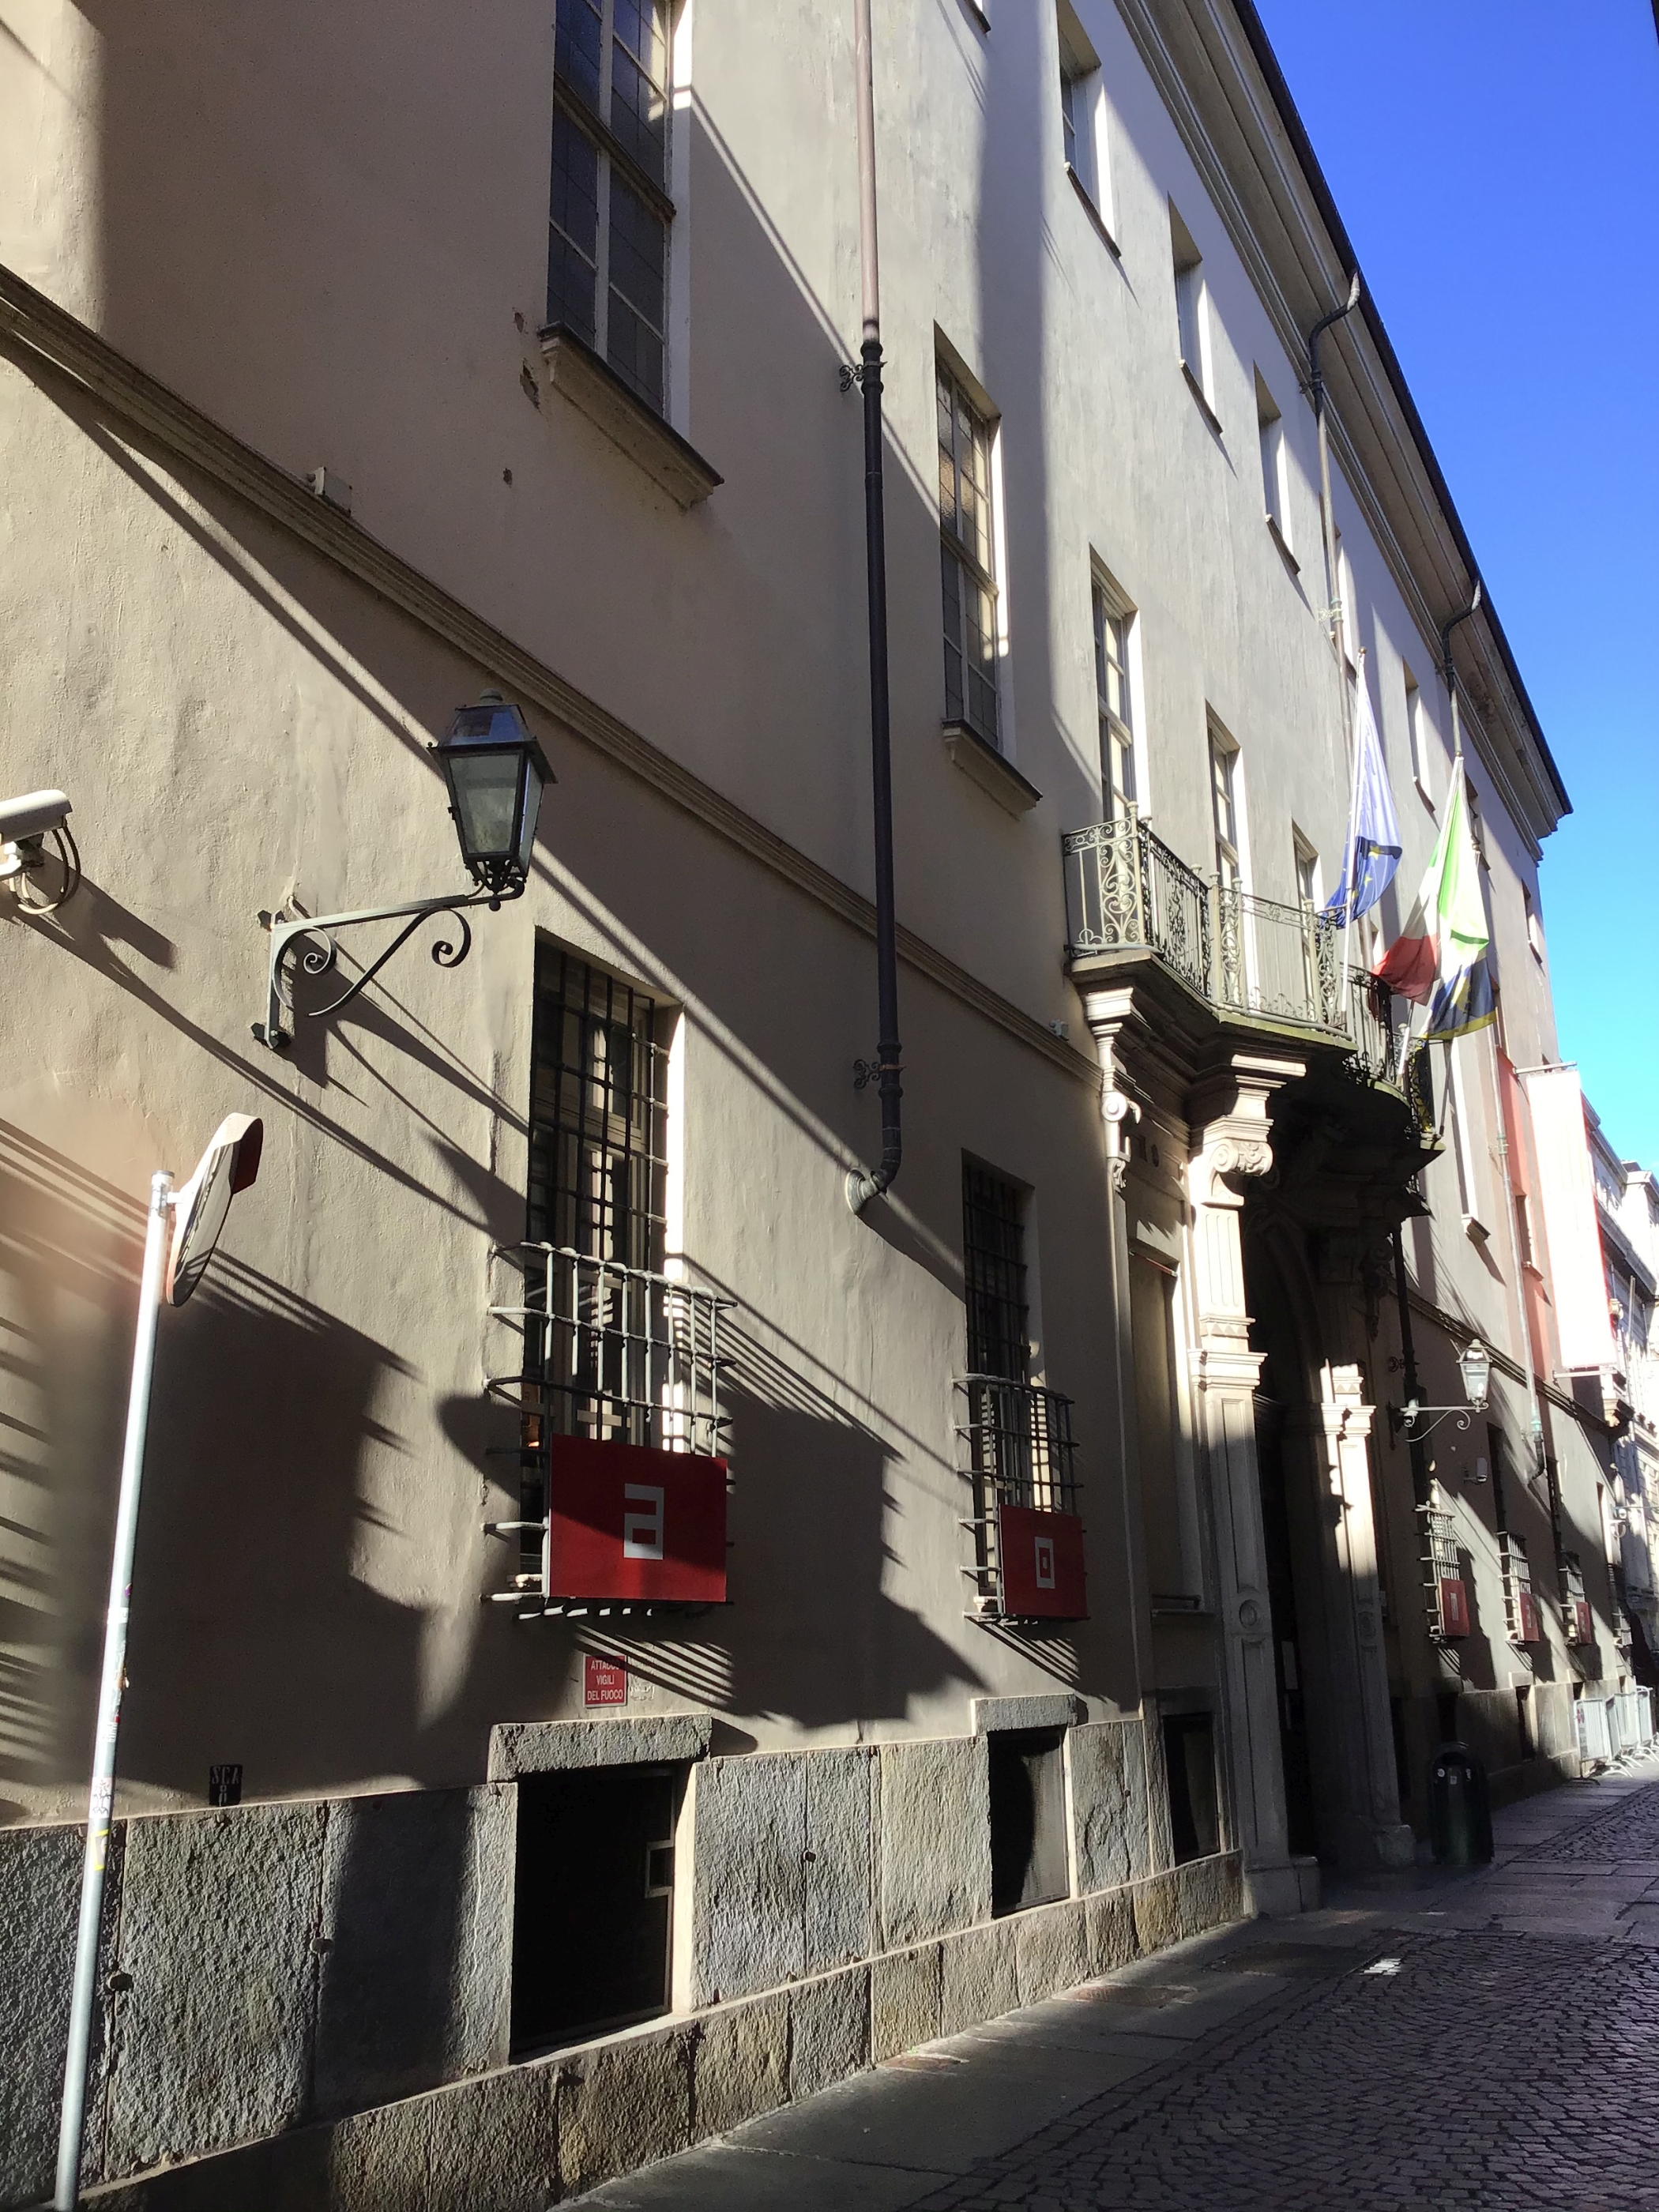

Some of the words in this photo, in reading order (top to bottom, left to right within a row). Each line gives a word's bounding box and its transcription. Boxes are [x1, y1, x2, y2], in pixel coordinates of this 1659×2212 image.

[591, 1660, 621, 1670] ATTAC
[596, 1675, 615, 1685] VIGILI
[587, 1691, 600, 1701] DEL
[601, 1689, 623, 1701] FUOCO
